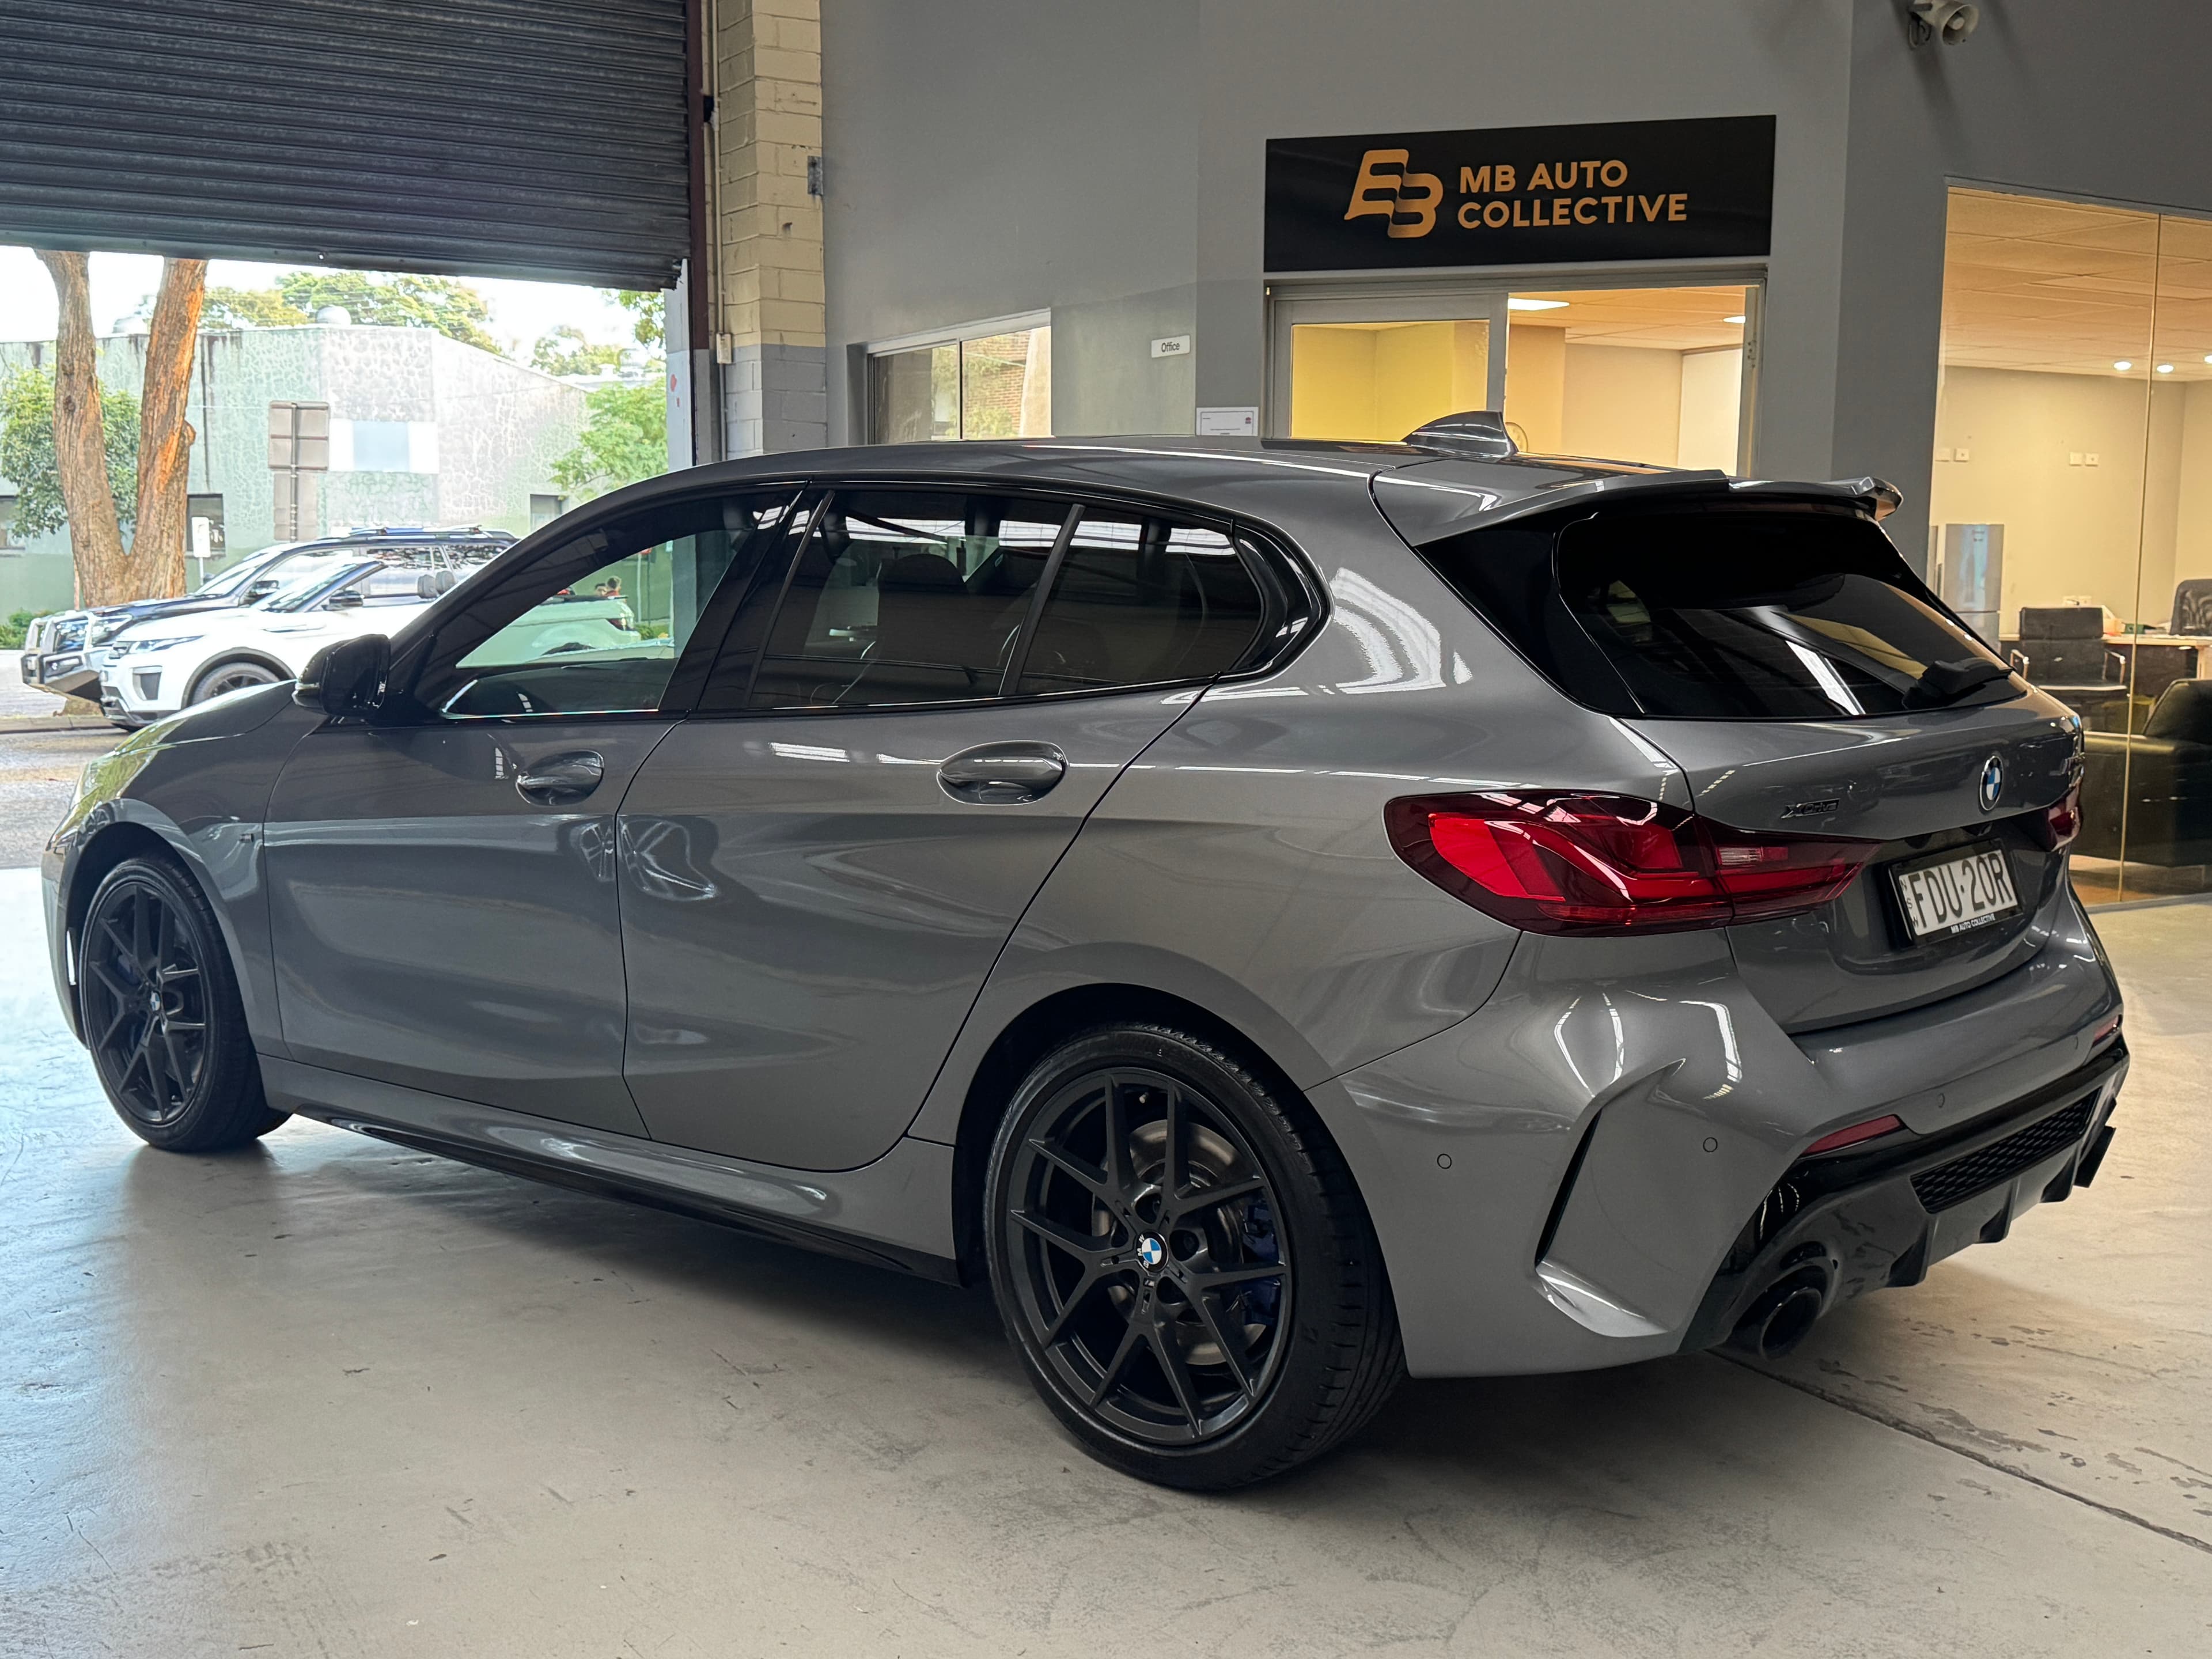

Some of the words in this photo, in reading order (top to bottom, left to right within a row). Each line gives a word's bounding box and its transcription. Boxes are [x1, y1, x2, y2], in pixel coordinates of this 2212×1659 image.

[1459, 165, 1516, 194] MB
[1528, 159, 1628, 191] AUTO
[1457, 193, 1688, 229] COLLECTIVE
[1161, 342, 1180, 353] Office
[1950, 925, 1960, 934] MB
[1959, 921, 1971, 931] AUTO
[1971, 913, 1996, 927] COLLECTIVE
